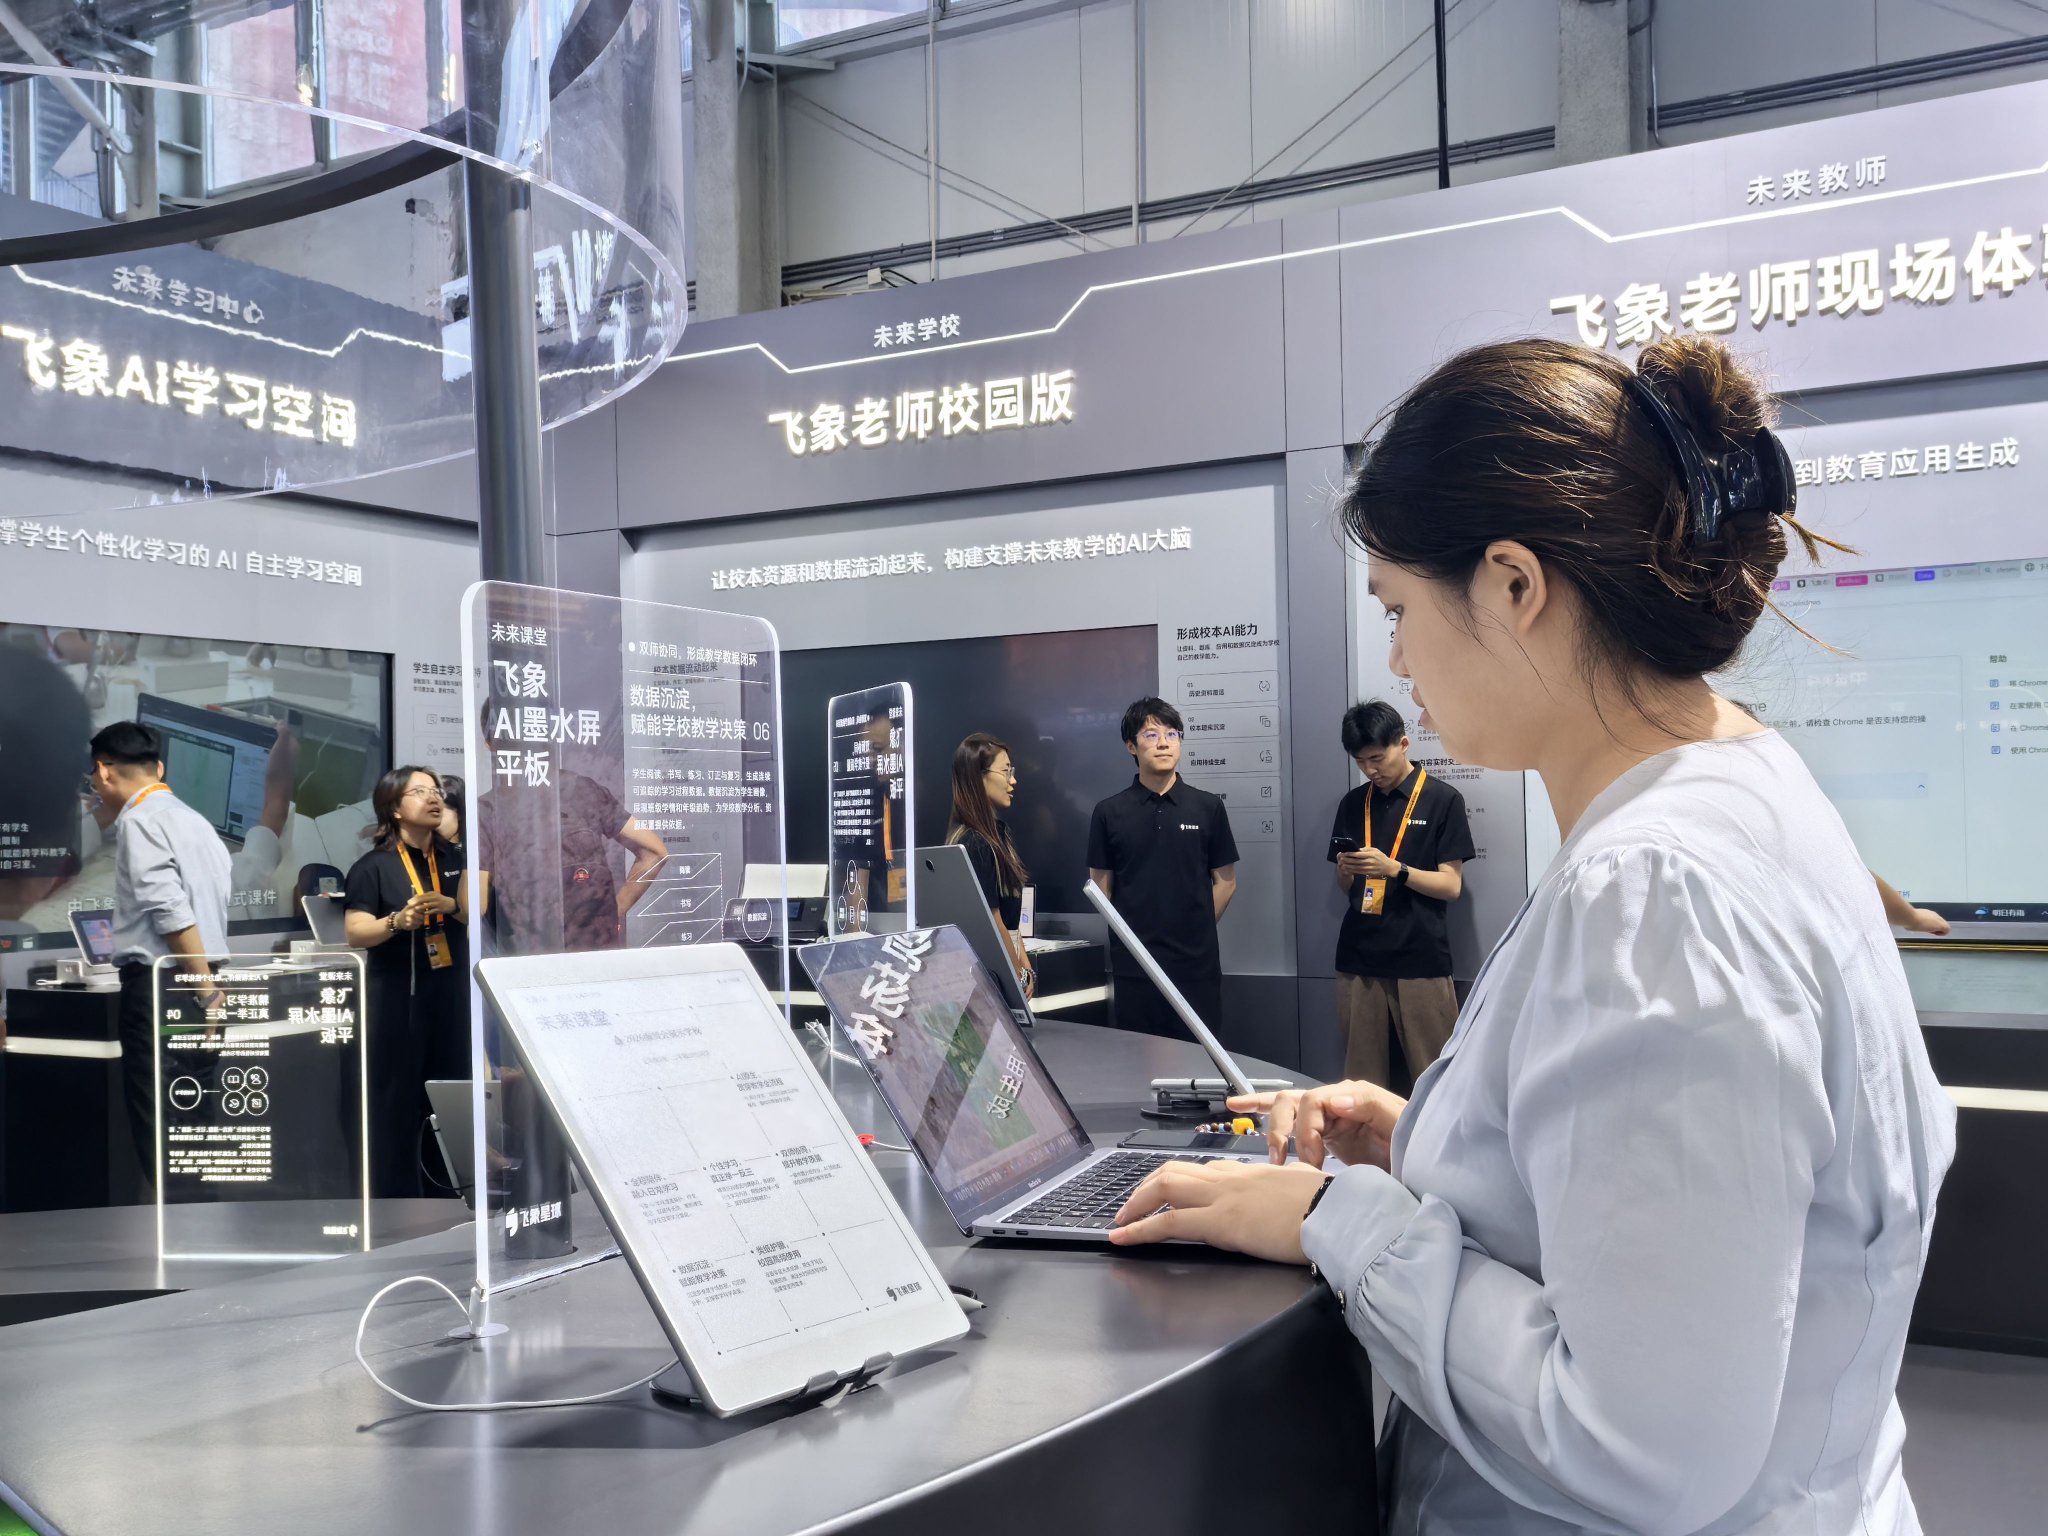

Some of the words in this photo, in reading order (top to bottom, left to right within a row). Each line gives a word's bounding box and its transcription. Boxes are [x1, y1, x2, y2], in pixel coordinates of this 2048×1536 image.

[1747, 155, 1888, 205] 未来教师
[111, 265, 264, 324] 未来学习中心
[1550, 221, 2048, 349] 飞象老师现场体
[873, 313, 962, 349] 未来学校
[1, 324, 359, 447] 飞象AI学习空间
[767, 369, 1076, 455] 飞象老师校园版
[1795, 437, 2021, 487] 到教育应用生成
[216, 550, 238, 570] AI
[246, 551, 363, 587] 自主学习空间
[710, 526, 1192, 591] 让校本资源和数据流动起来，构建支撑未来教学的AI大脑
[491, 622, 548, 646] 未来课堂
[1176, 623, 1258, 640] 形成校本AI能力
[639, 641, 758, 667] 双师协同，形成教学数据闭环
[1989, 655, 2007, 663] 帮助
[493, 660, 548, 699] 飞象
[630, 684, 697, 713] 数据沉淀，
[494, 706, 601, 746] AI墨水屏
[631, 713, 747, 741] 赋能学校教学决策
[753, 721, 770, 741] 06
[1832, 717, 1864, 726] Chrome
[1866, 714, 1927, 725] 是否支持您的操
[496, 749, 552, 787] 平板
[0, 823, 29, 833] 有学生
[536, 1008, 613, 1031] 未来课堂
[710, 1168, 754, 1183] 真正举一反三
[519, 1201, 562, 1228] 飞象星球
[757, 1249, 802, 1267] 校园高频使用
[678, 1268, 728, 1288] 赋能教学决策
